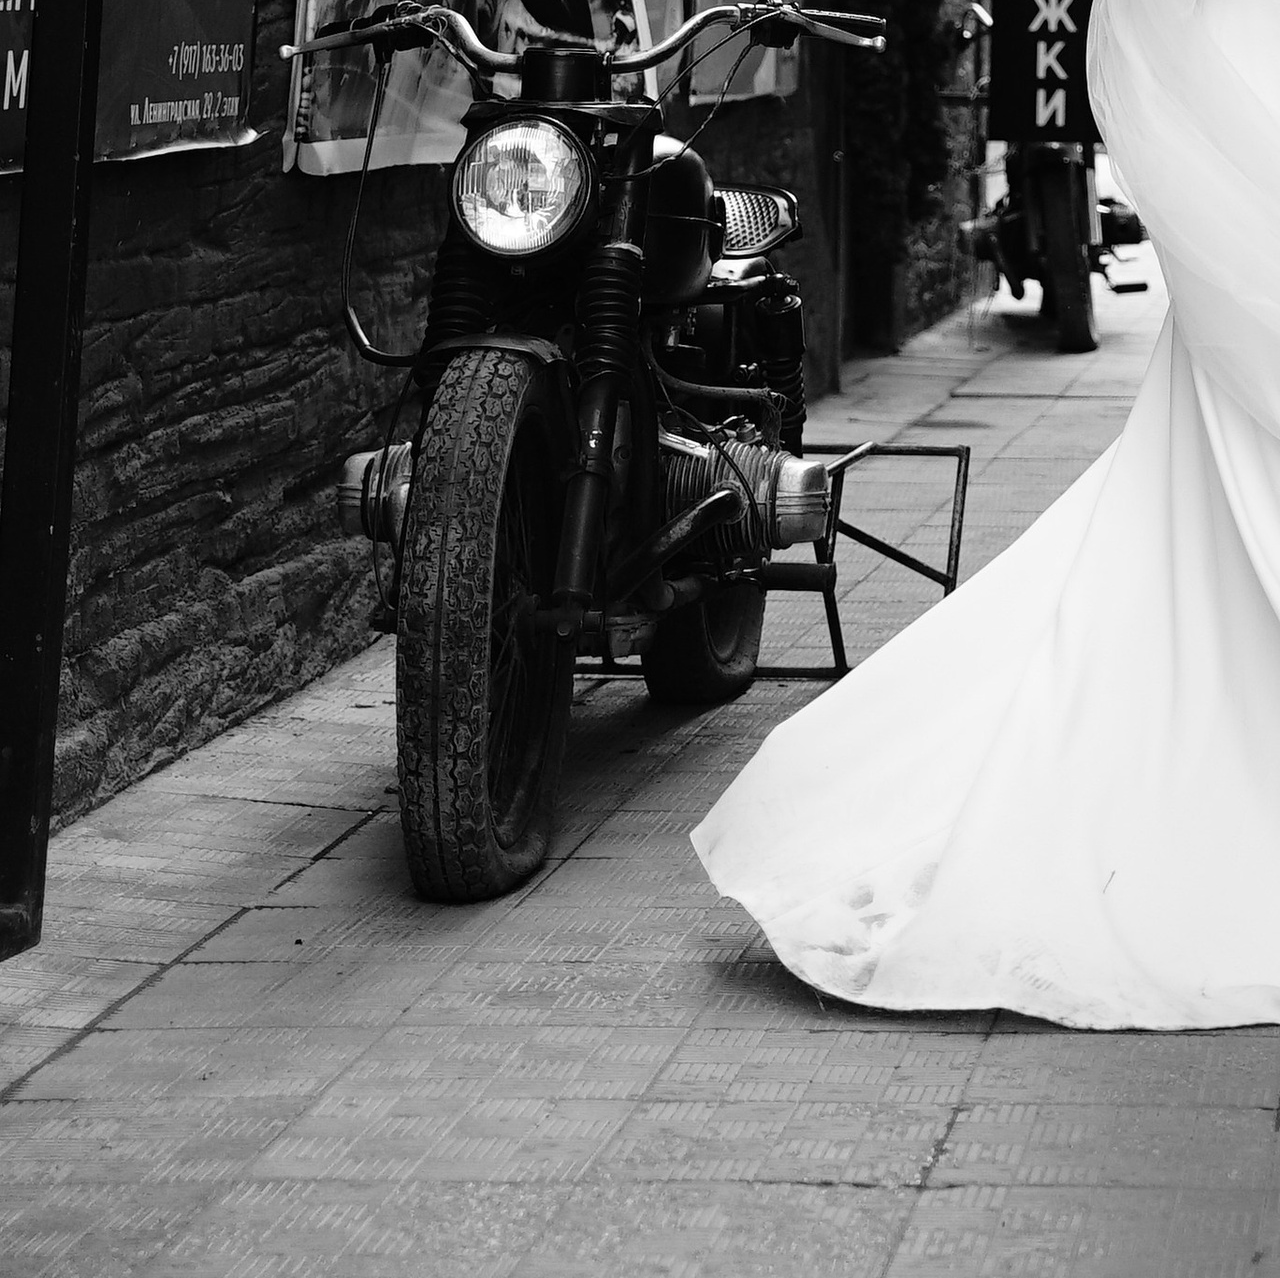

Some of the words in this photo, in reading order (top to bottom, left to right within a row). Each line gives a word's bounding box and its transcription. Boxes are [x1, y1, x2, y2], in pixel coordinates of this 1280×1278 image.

[168, 45, 179, 74] +7
[179, 41, 200, 80] (917)
[202, 43, 244, 73] 163-36-03
[215, 91, 222, 117] 2
